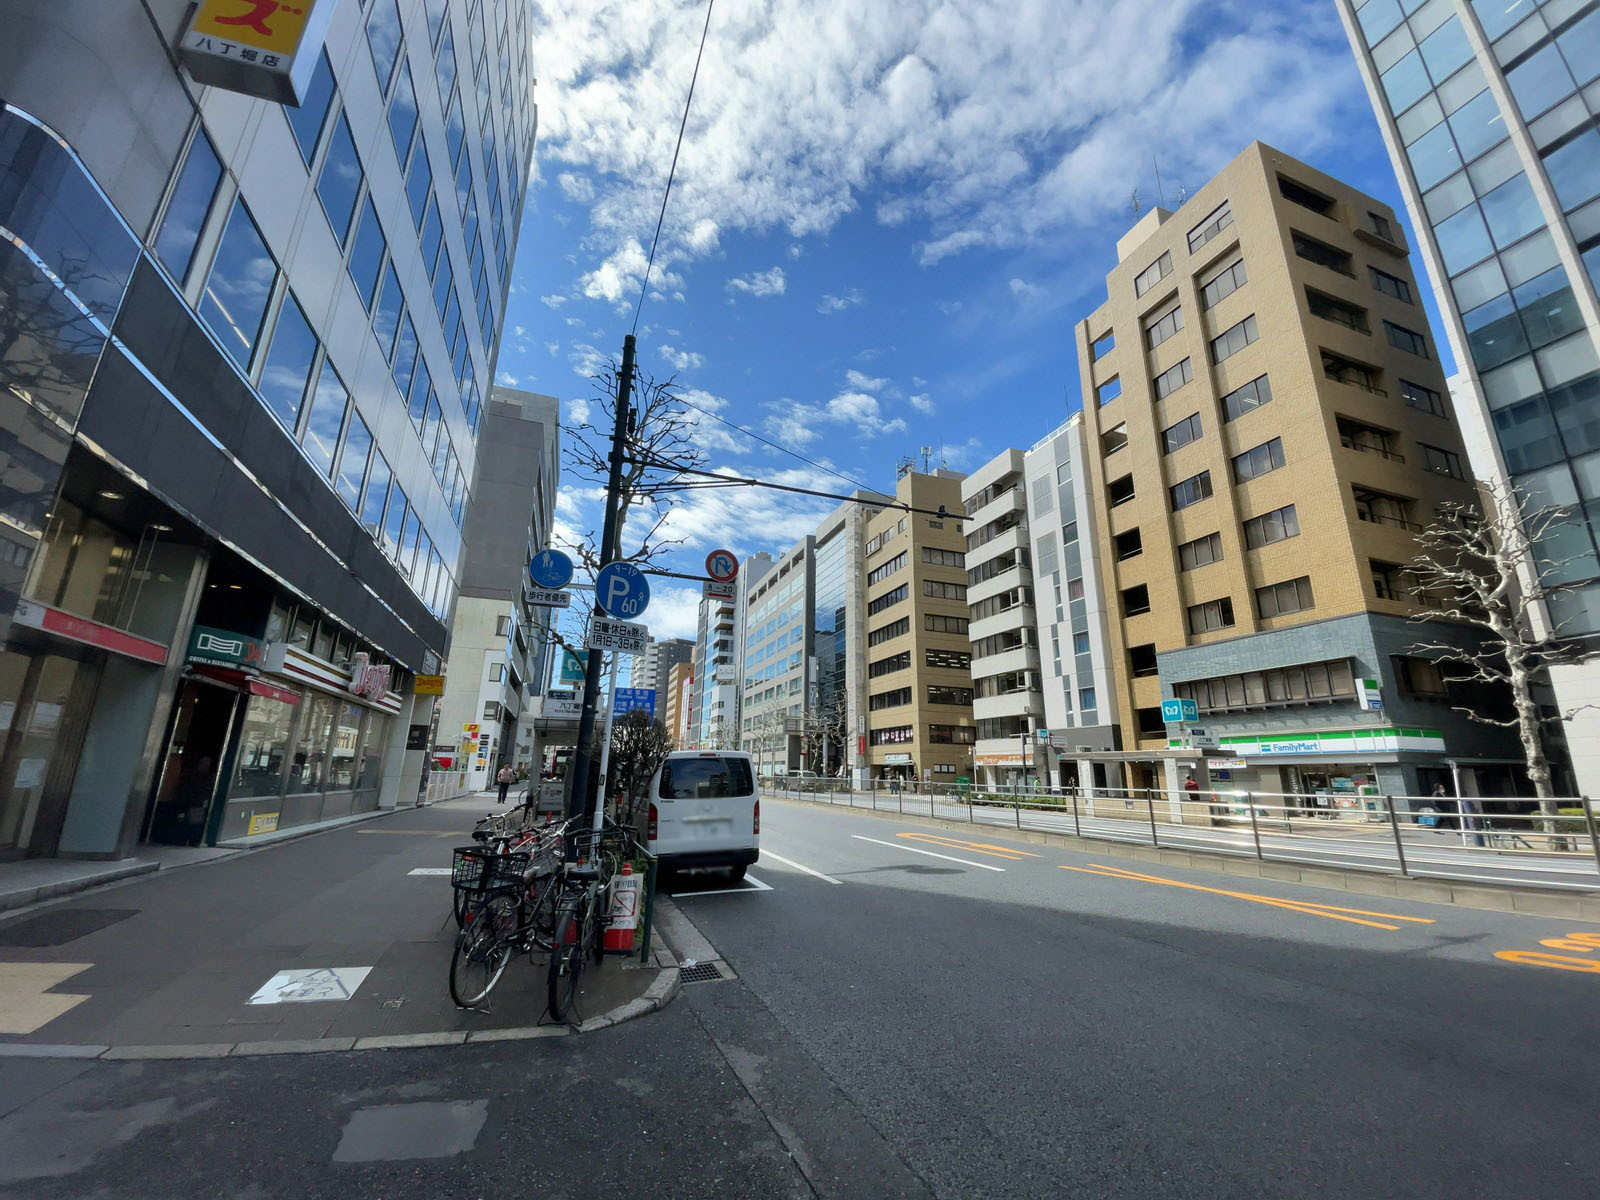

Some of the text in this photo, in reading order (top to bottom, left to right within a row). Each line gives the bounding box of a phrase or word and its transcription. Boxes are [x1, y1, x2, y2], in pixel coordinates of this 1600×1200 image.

[195, 37, 281, 68] 八丁堀店
[614, 563, 638, 577] 9-19
[528, 591, 568, 603] 歩行者優先
[606, 575, 630, 610] P
[560, 702, 583, 710] 八丁堀
[1273, 742, 1318, 752] FamilyMart
